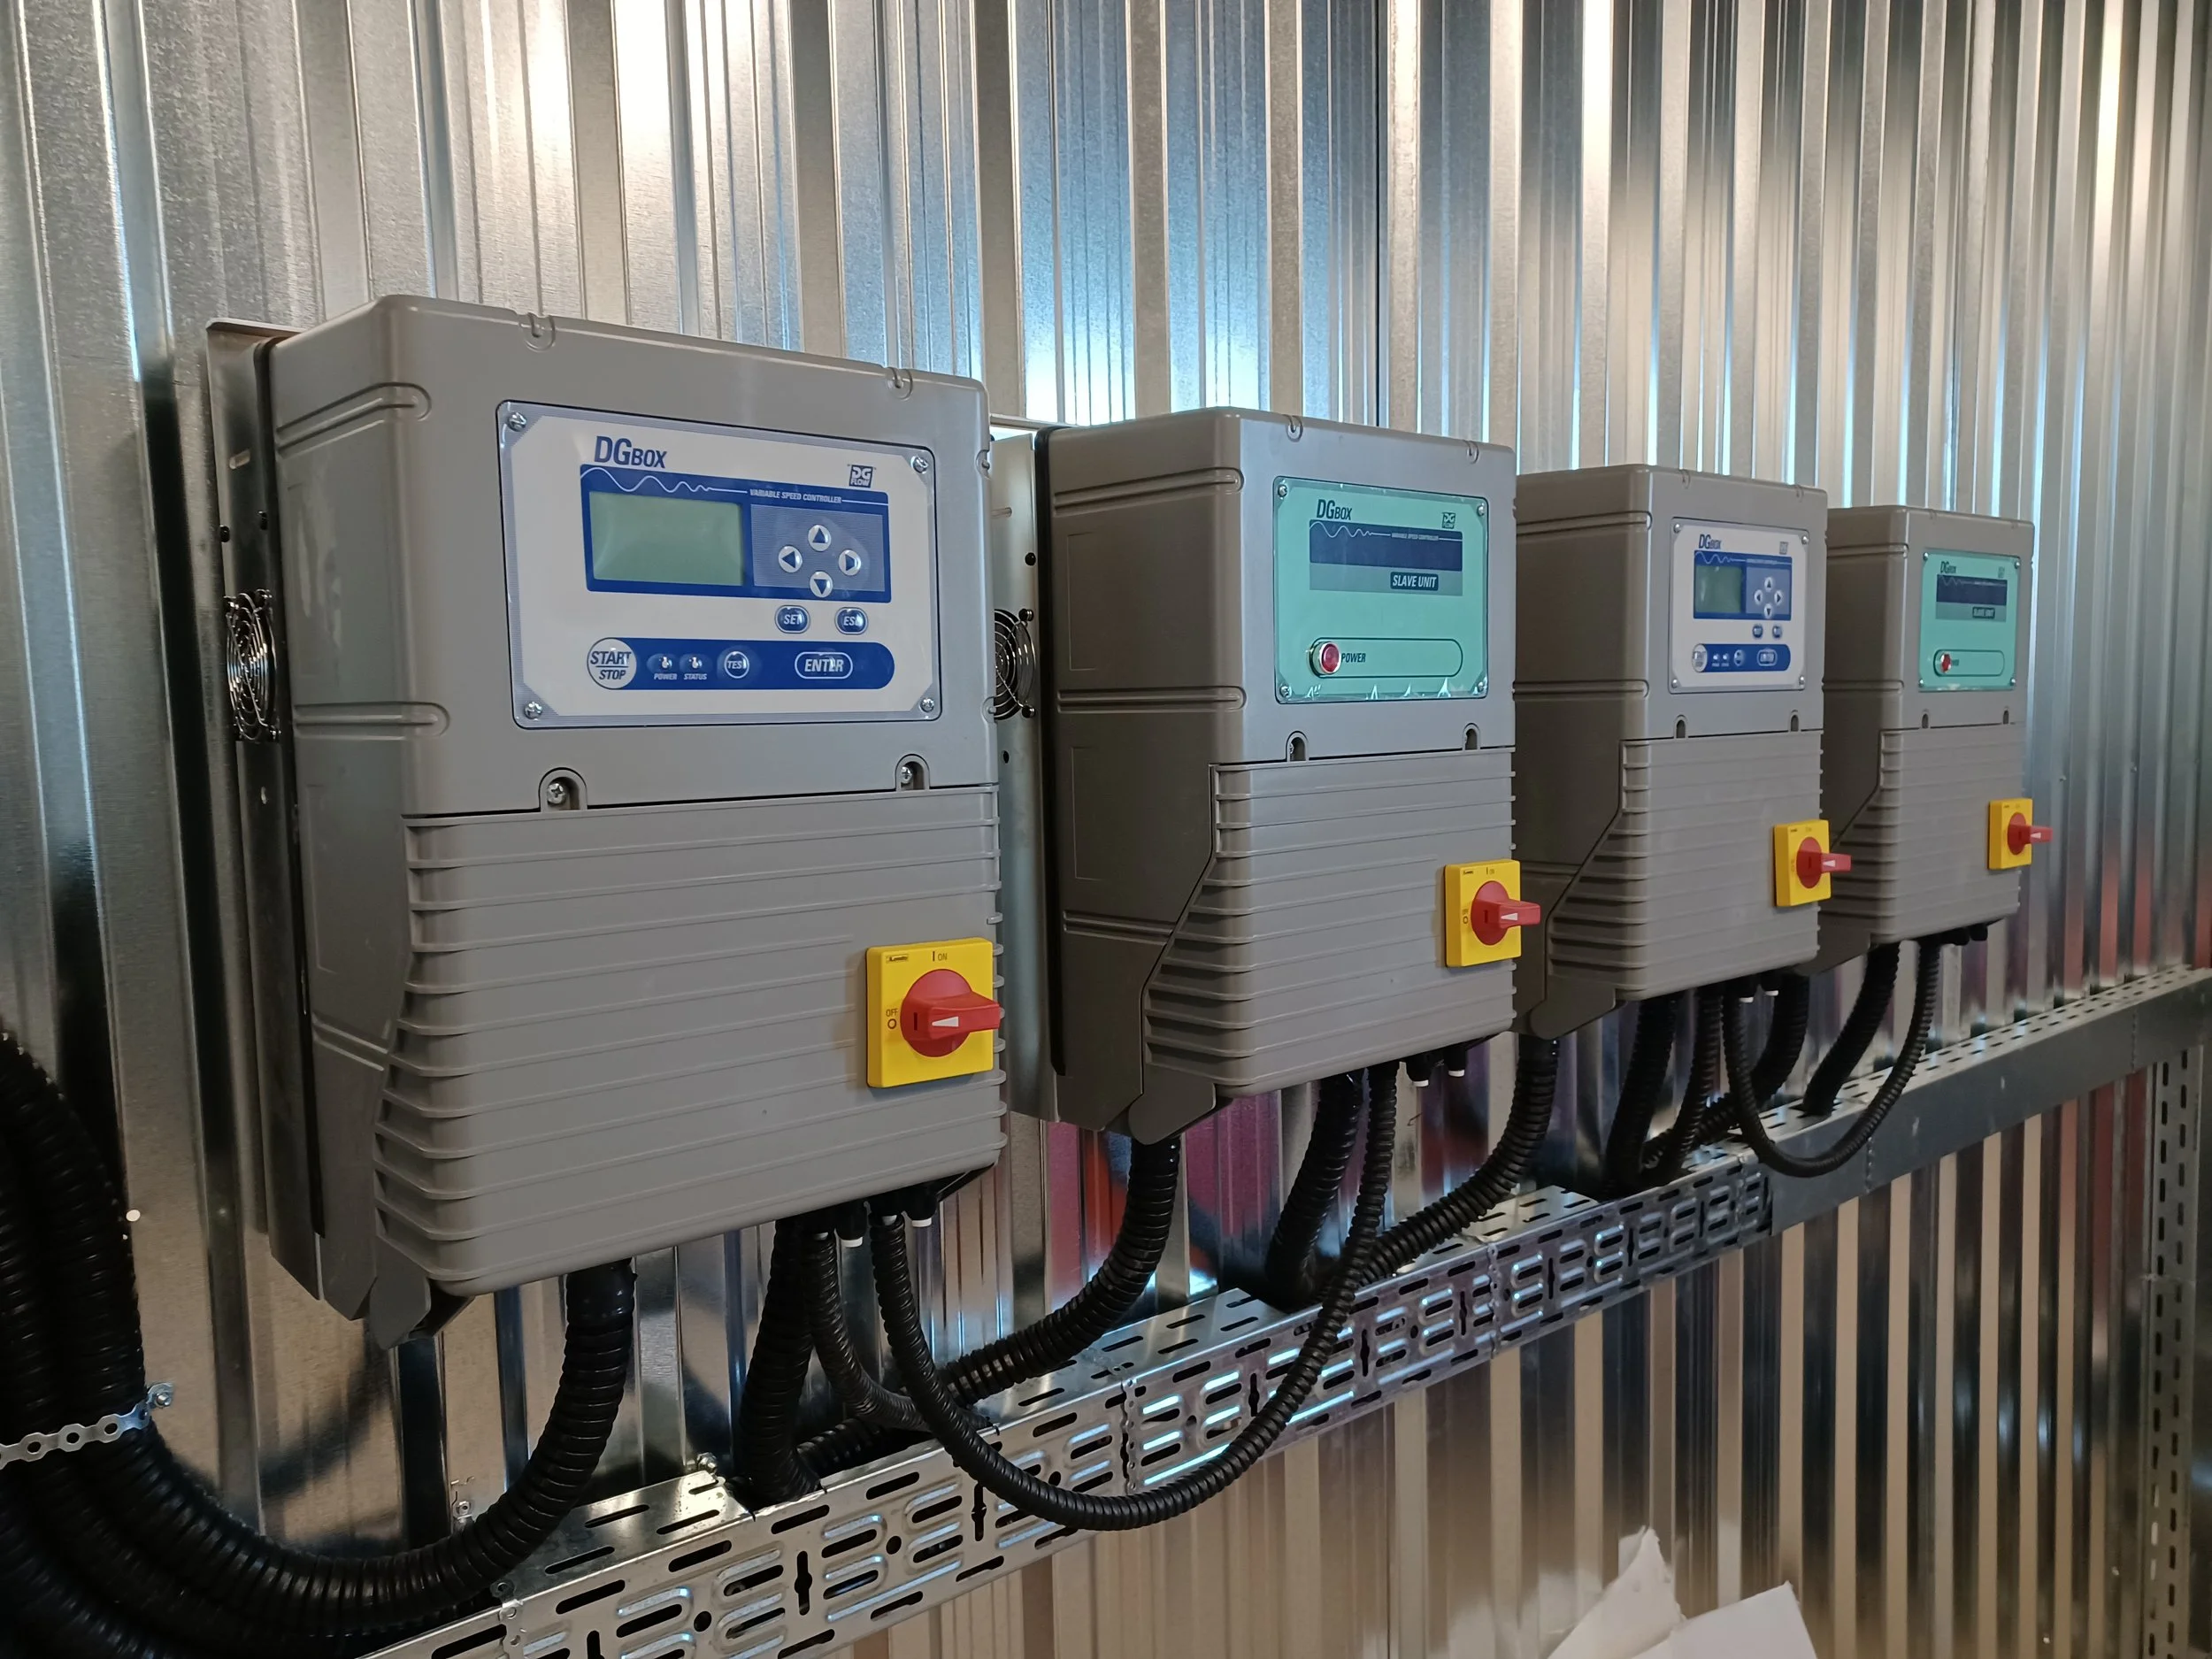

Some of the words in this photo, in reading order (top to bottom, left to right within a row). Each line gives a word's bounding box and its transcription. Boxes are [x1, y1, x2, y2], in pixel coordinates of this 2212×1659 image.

[749, 488, 780, 499] VARIABLE
[781, 491, 802, 501] SPEED
[803, 493, 842, 503] CONTROLLER
[1393, 574, 1417, 588] SLAVE
[1417, 576, 1438, 588] UNIT
[589, 650, 632, 664] START
[1340, 652, 1366, 664] POWER
[804, 658, 844, 672] ENTER
[599, 669, 626, 680] STOP
[938, 952, 948, 962] ON
[886, 1008, 899, 1018] OFF
